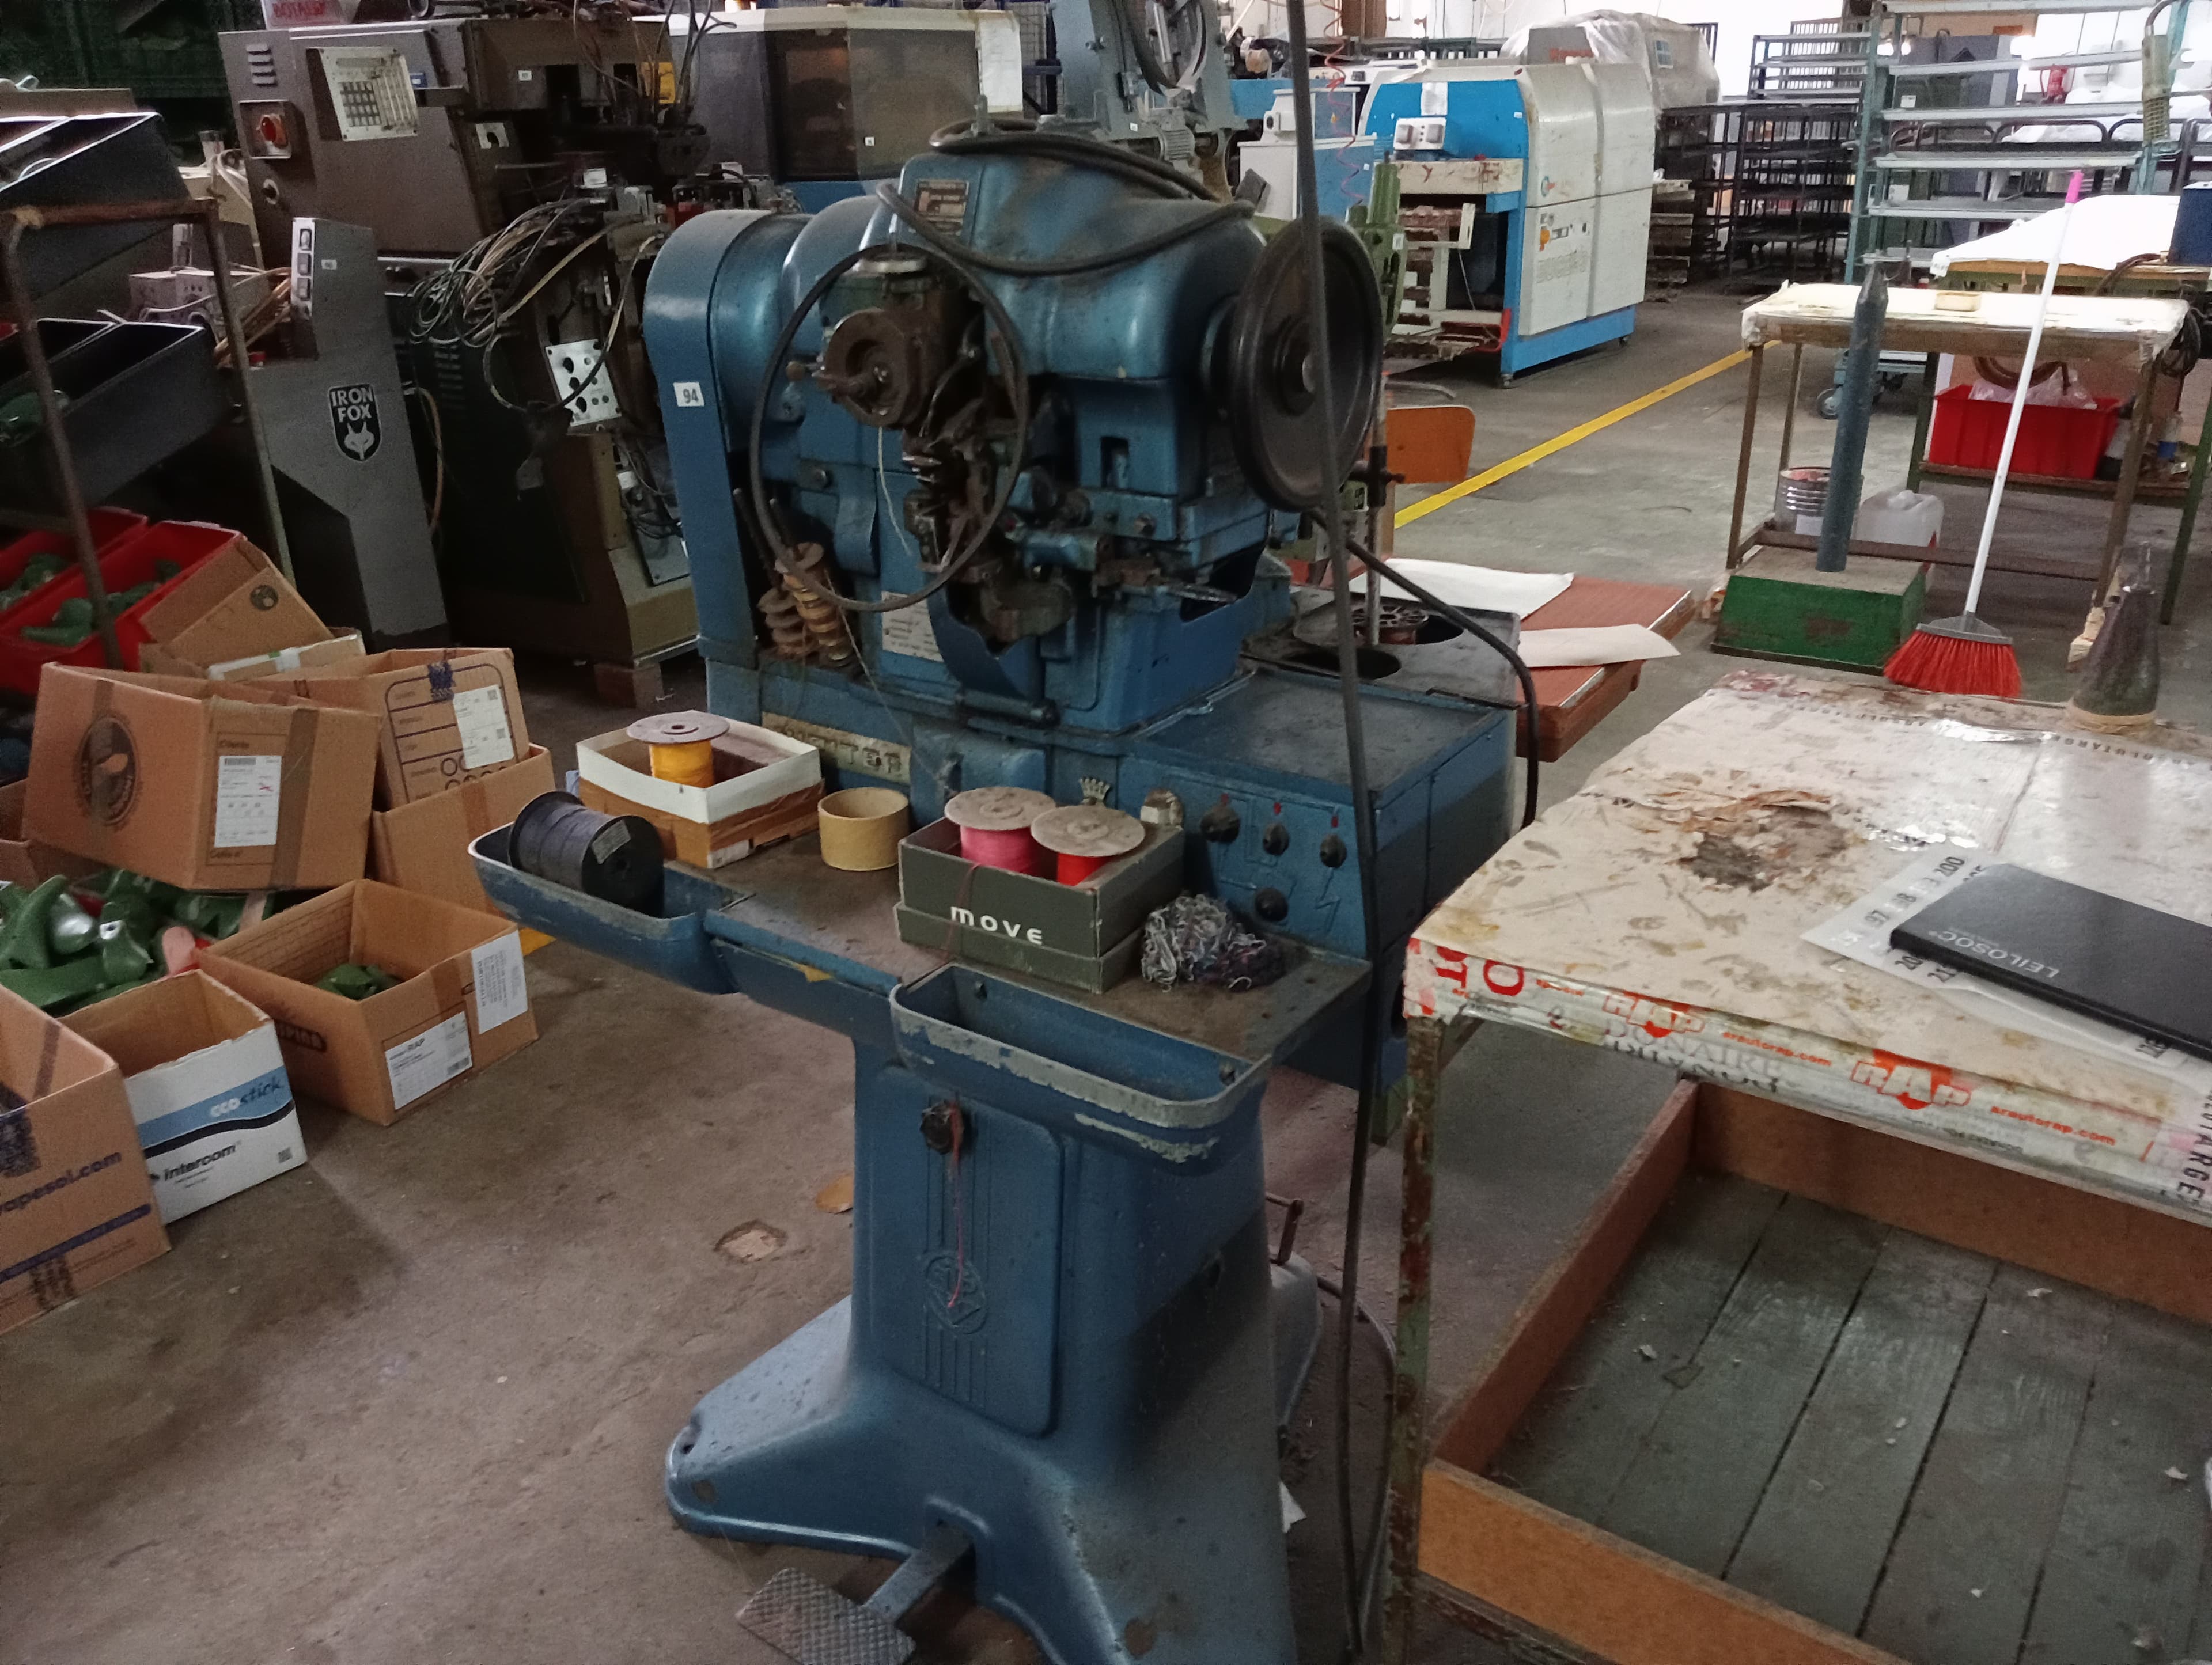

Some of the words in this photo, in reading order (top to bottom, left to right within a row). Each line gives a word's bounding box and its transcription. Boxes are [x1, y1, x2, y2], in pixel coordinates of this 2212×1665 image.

[331, 388, 373, 407] IRON
[683, 389, 699, 404] 94
[338, 404, 372, 423] FOX
